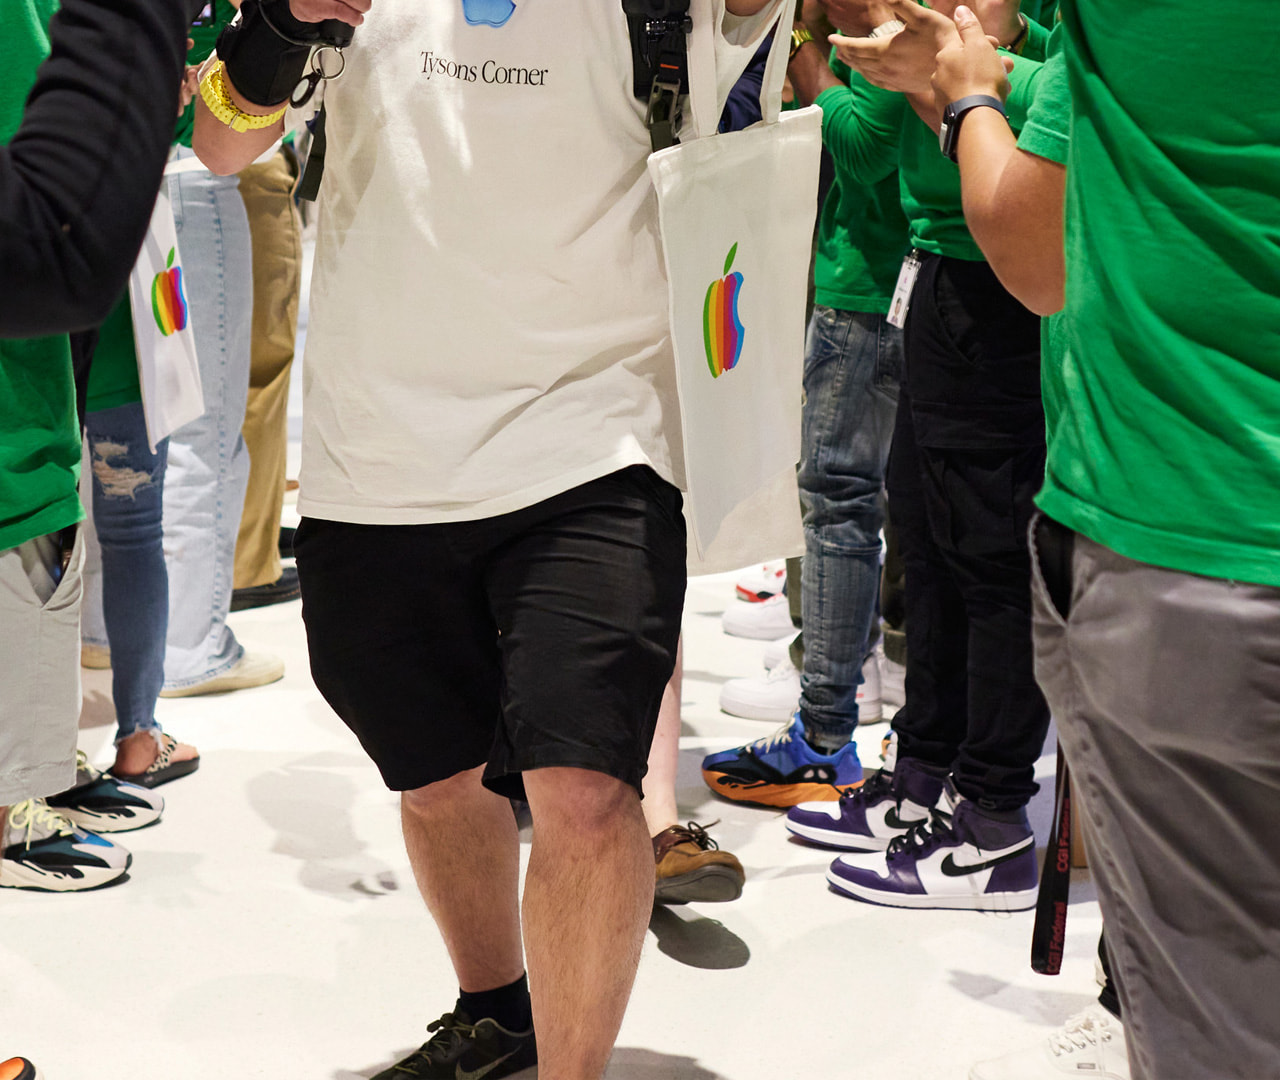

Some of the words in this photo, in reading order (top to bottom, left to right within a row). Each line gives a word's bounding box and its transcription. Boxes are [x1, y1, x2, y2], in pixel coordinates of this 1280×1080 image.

[420, 51, 478, 83] Tysons
[481, 60, 549, 86] Corner
[1056, 848, 1069, 873] CGI
[1049, 901, 1066, 950] Federal
[1047, 952, 1060, 973] CGI
